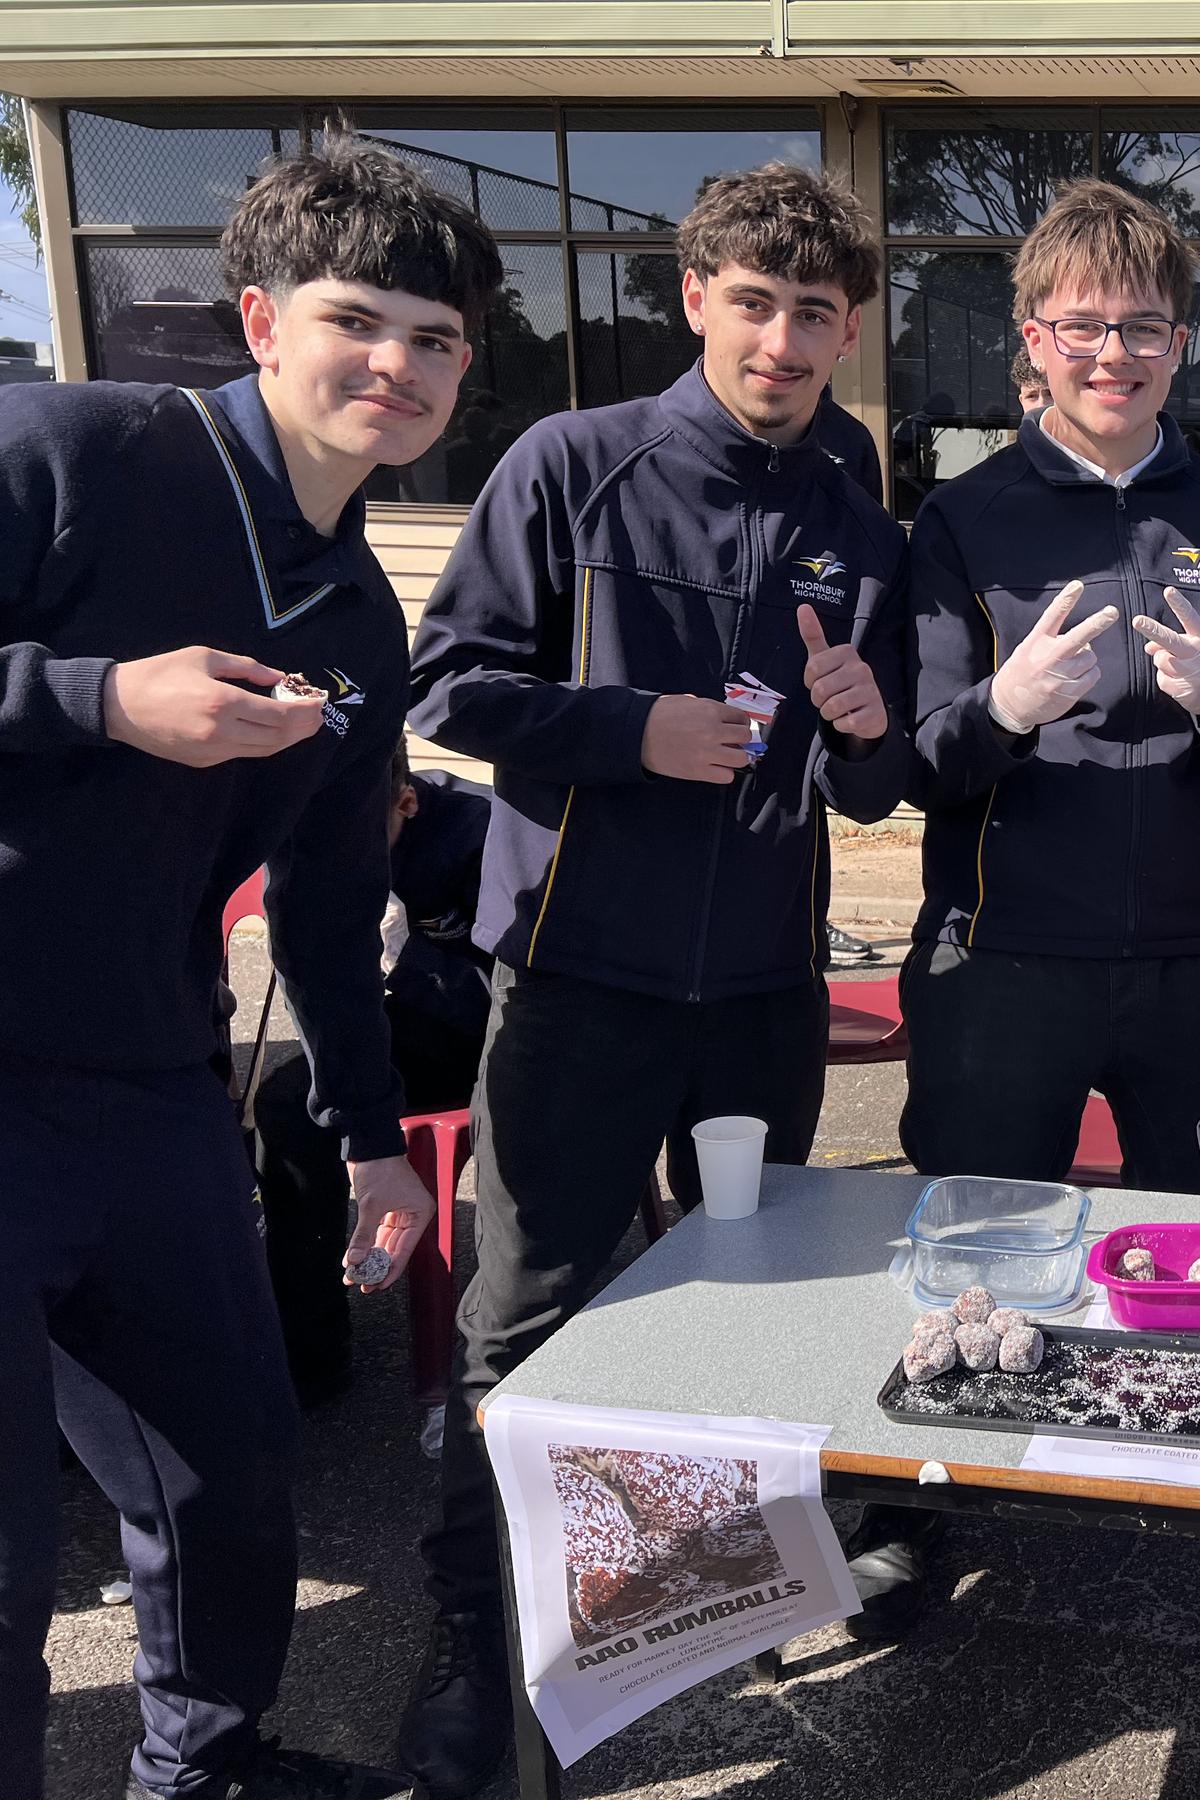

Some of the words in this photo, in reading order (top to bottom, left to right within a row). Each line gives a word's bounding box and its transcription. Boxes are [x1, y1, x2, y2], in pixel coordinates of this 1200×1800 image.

[790, 579, 846, 598] THORNBURY
[1178, 576, 1196, 584] HIGH
[794, 588, 815, 598] HIGH
[1111, 1445, 1162, 1455] CHOCOLATE
[1164, 1449, 1198, 1460] COATED
[575, 1637, 639, 1671] AAO
[642, 1580, 806, 1645] RUMBALLS
[619, 1668, 666, 1694] CHOCOLATE
[667, 1653, 698, 1670] COATED
[699, 1646, 715, 1657] AND
[717, 1634, 746, 1649] NORMAL
[750, 1617, 790, 1636] AVAILABLE
[680, 1635, 726, 1656] LUNCHTIME
[598, 1667, 625, 1683] READY
[626, 1660, 643, 1671] FOR
[678, 1640, 693, 1650] DAY
[695, 1633, 711, 1642] THE
